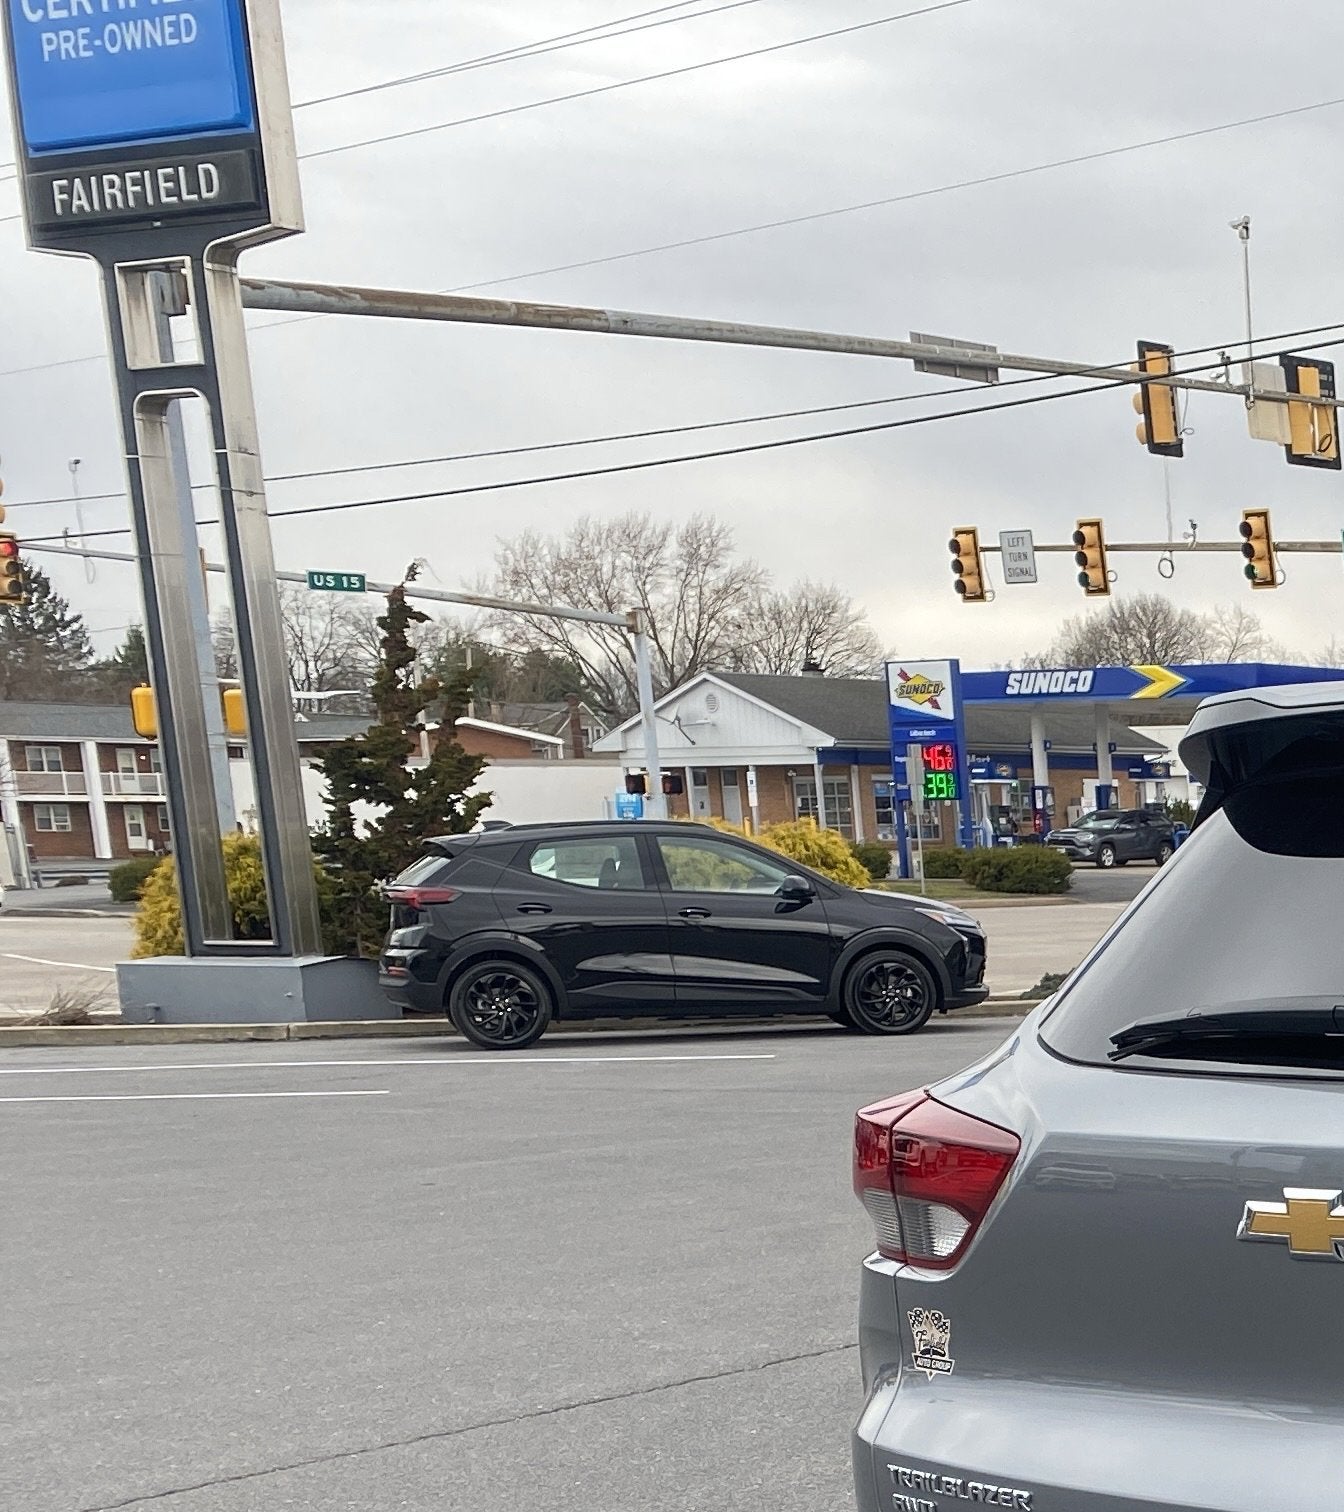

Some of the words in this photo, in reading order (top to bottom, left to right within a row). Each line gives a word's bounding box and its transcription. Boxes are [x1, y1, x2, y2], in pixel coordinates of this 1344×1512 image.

[41, 13, 198, 62] PRE-OWNED
[52, 162, 220, 216] FAIRFIELD
[1007, 536, 1025, 548] LEFT
[1009, 551, 1029, 563] TURN
[1007, 566, 1034, 578] SIGNAL
[313, 574, 336, 587] US
[341, 576, 361, 589] 15
[898, 682, 940, 696] SUNOCO
[1005, 670, 1095, 695] SUNOCO
[886, 1463, 1034, 1512] TRAILBLAZER
